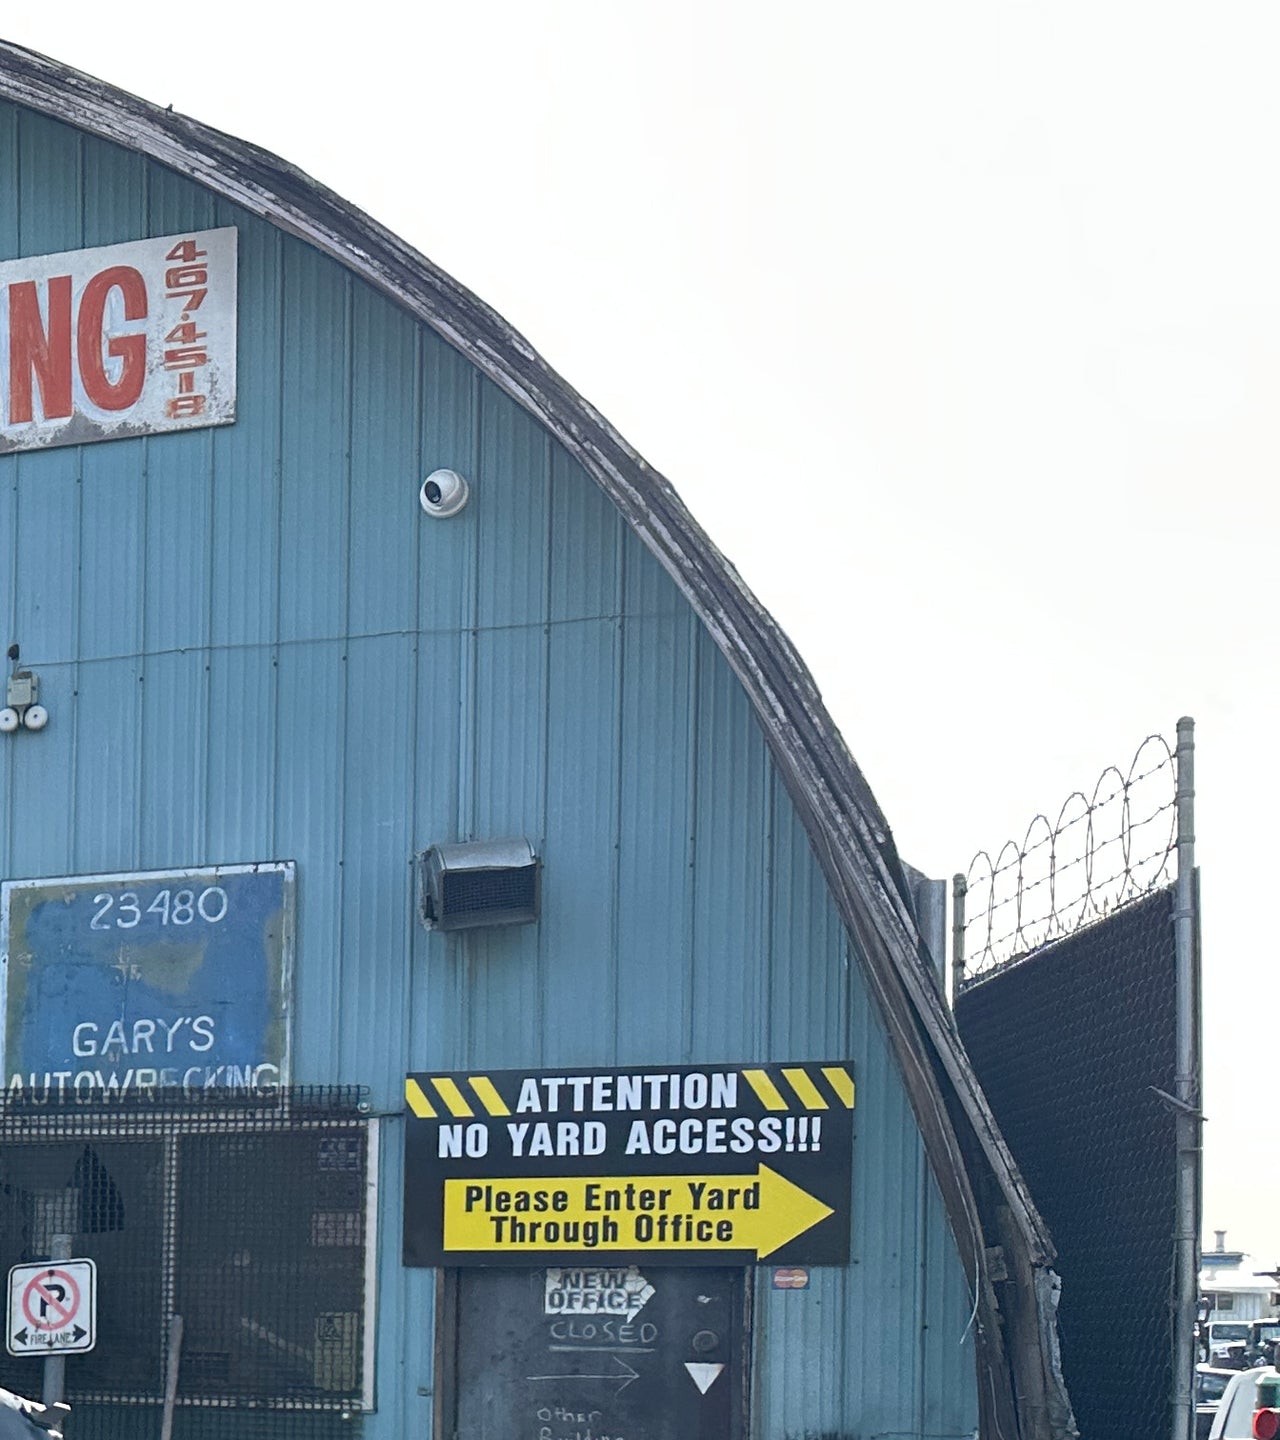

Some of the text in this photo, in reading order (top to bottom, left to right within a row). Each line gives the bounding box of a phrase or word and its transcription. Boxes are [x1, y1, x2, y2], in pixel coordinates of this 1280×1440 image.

[90, 886, 228, 930] 23480
[72, 1016, 215, 1057] GARY'S
[516, 1072, 738, 1113] ATTENTION
[438, 1116, 822, 1158] NO YARD ACCESS!!!
[465, 1182, 761, 1212] Please Enter Yard
[489, 1213, 733, 1248] Through Office
[560, 1270, 629, 1290] NEW
[548, 1289, 640, 1312] OFFICE
[550, 1321, 658, 1344] CLOSED
